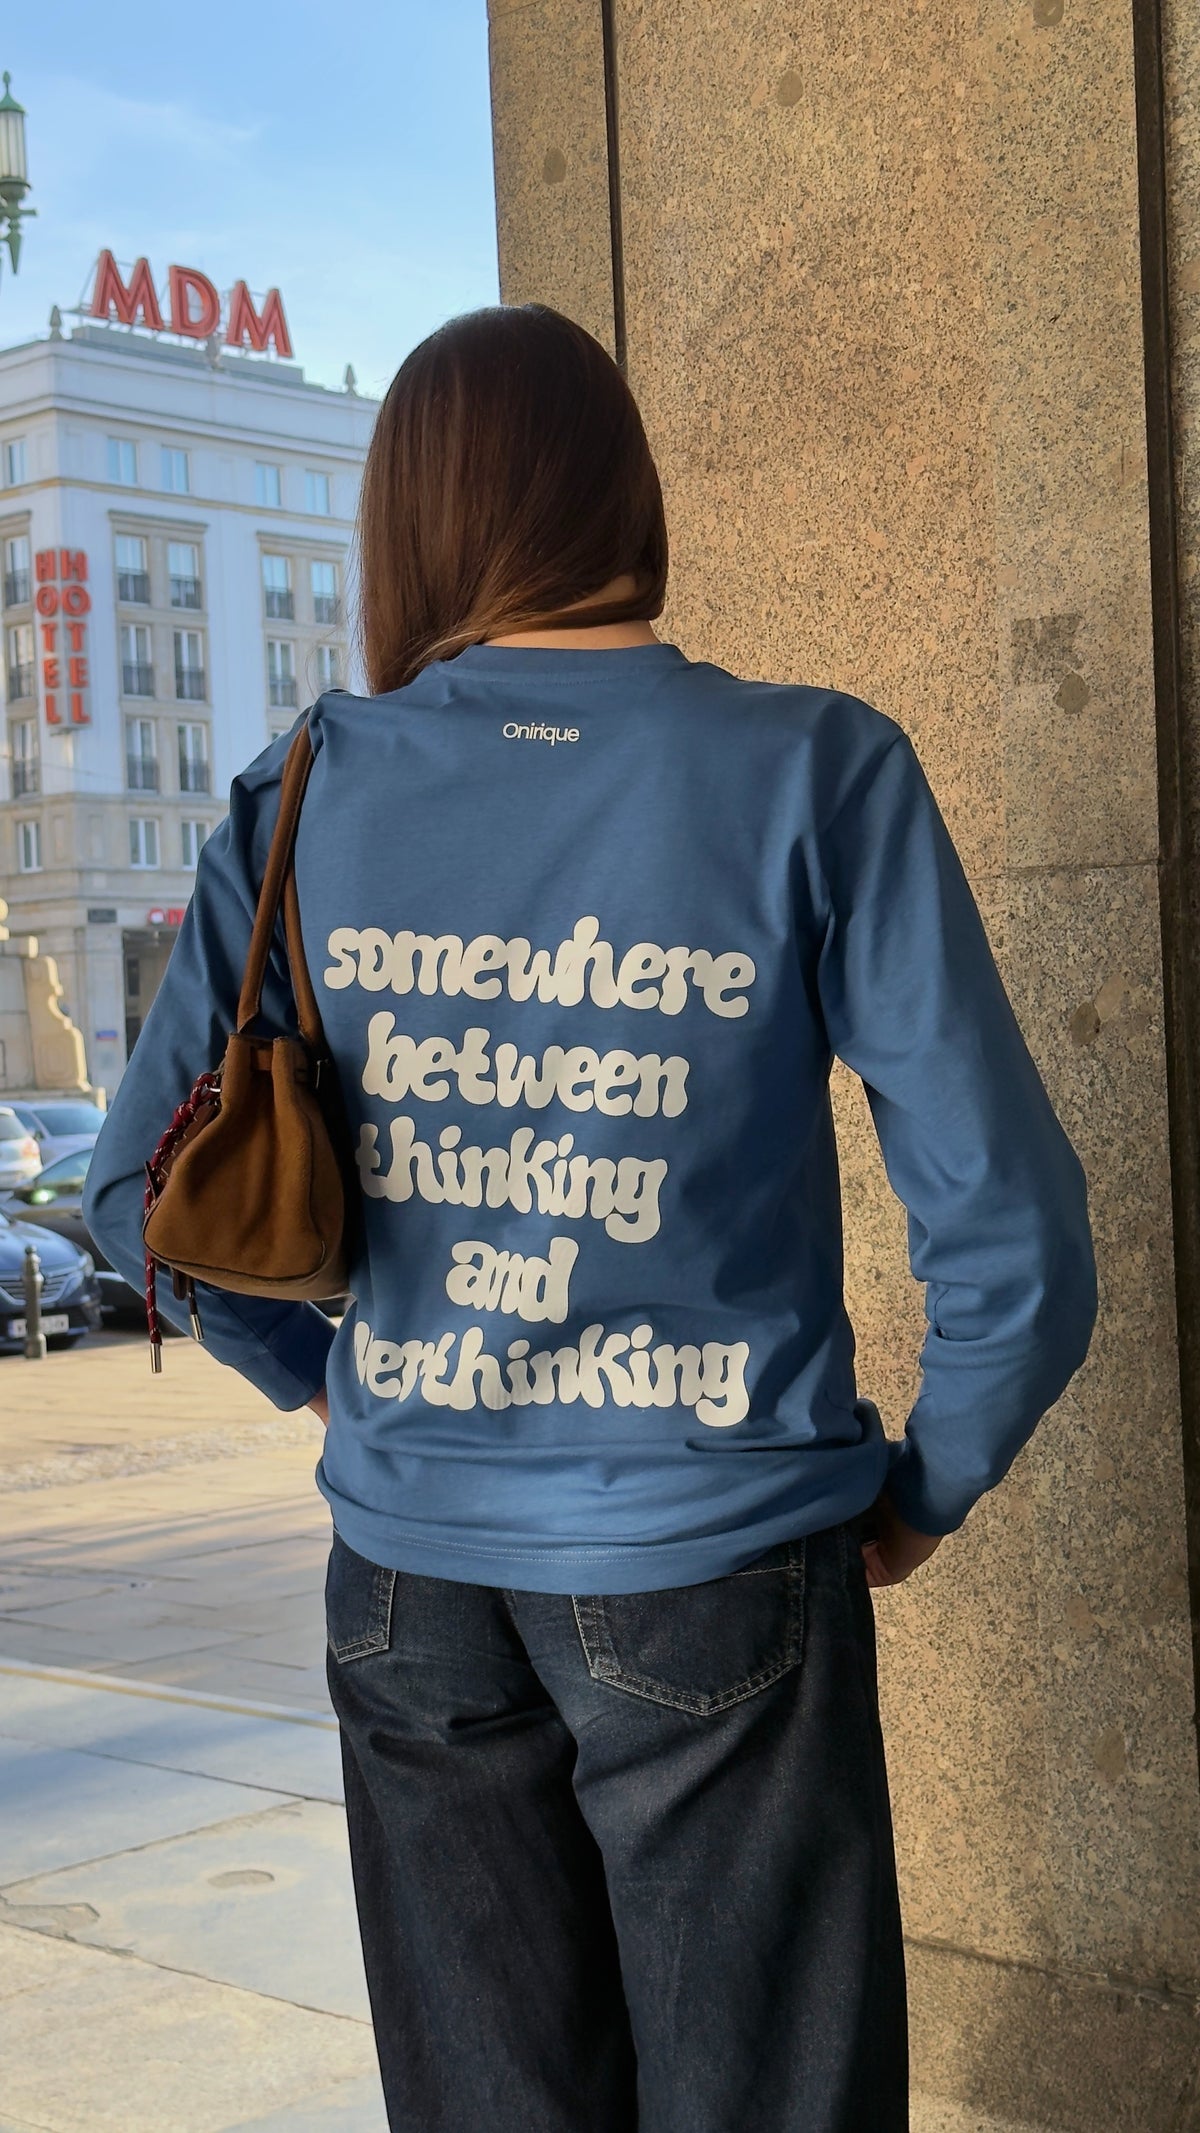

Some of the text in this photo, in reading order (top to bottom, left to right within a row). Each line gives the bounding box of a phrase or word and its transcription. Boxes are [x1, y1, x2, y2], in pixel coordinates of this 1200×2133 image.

[91, 249, 293, 358] MDM
[36, 550, 61, 724] HOTEL
[61, 549, 91, 724] HOTEL
[502, 722, 580, 746] Onirique
[324, 916, 755, 1018] somewhere
[362, 1011, 689, 1118] between
[355, 1116, 667, 1243] thinking
[446, 1236, 578, 1323] and
[354, 1321, 750, 1427] verthinking
